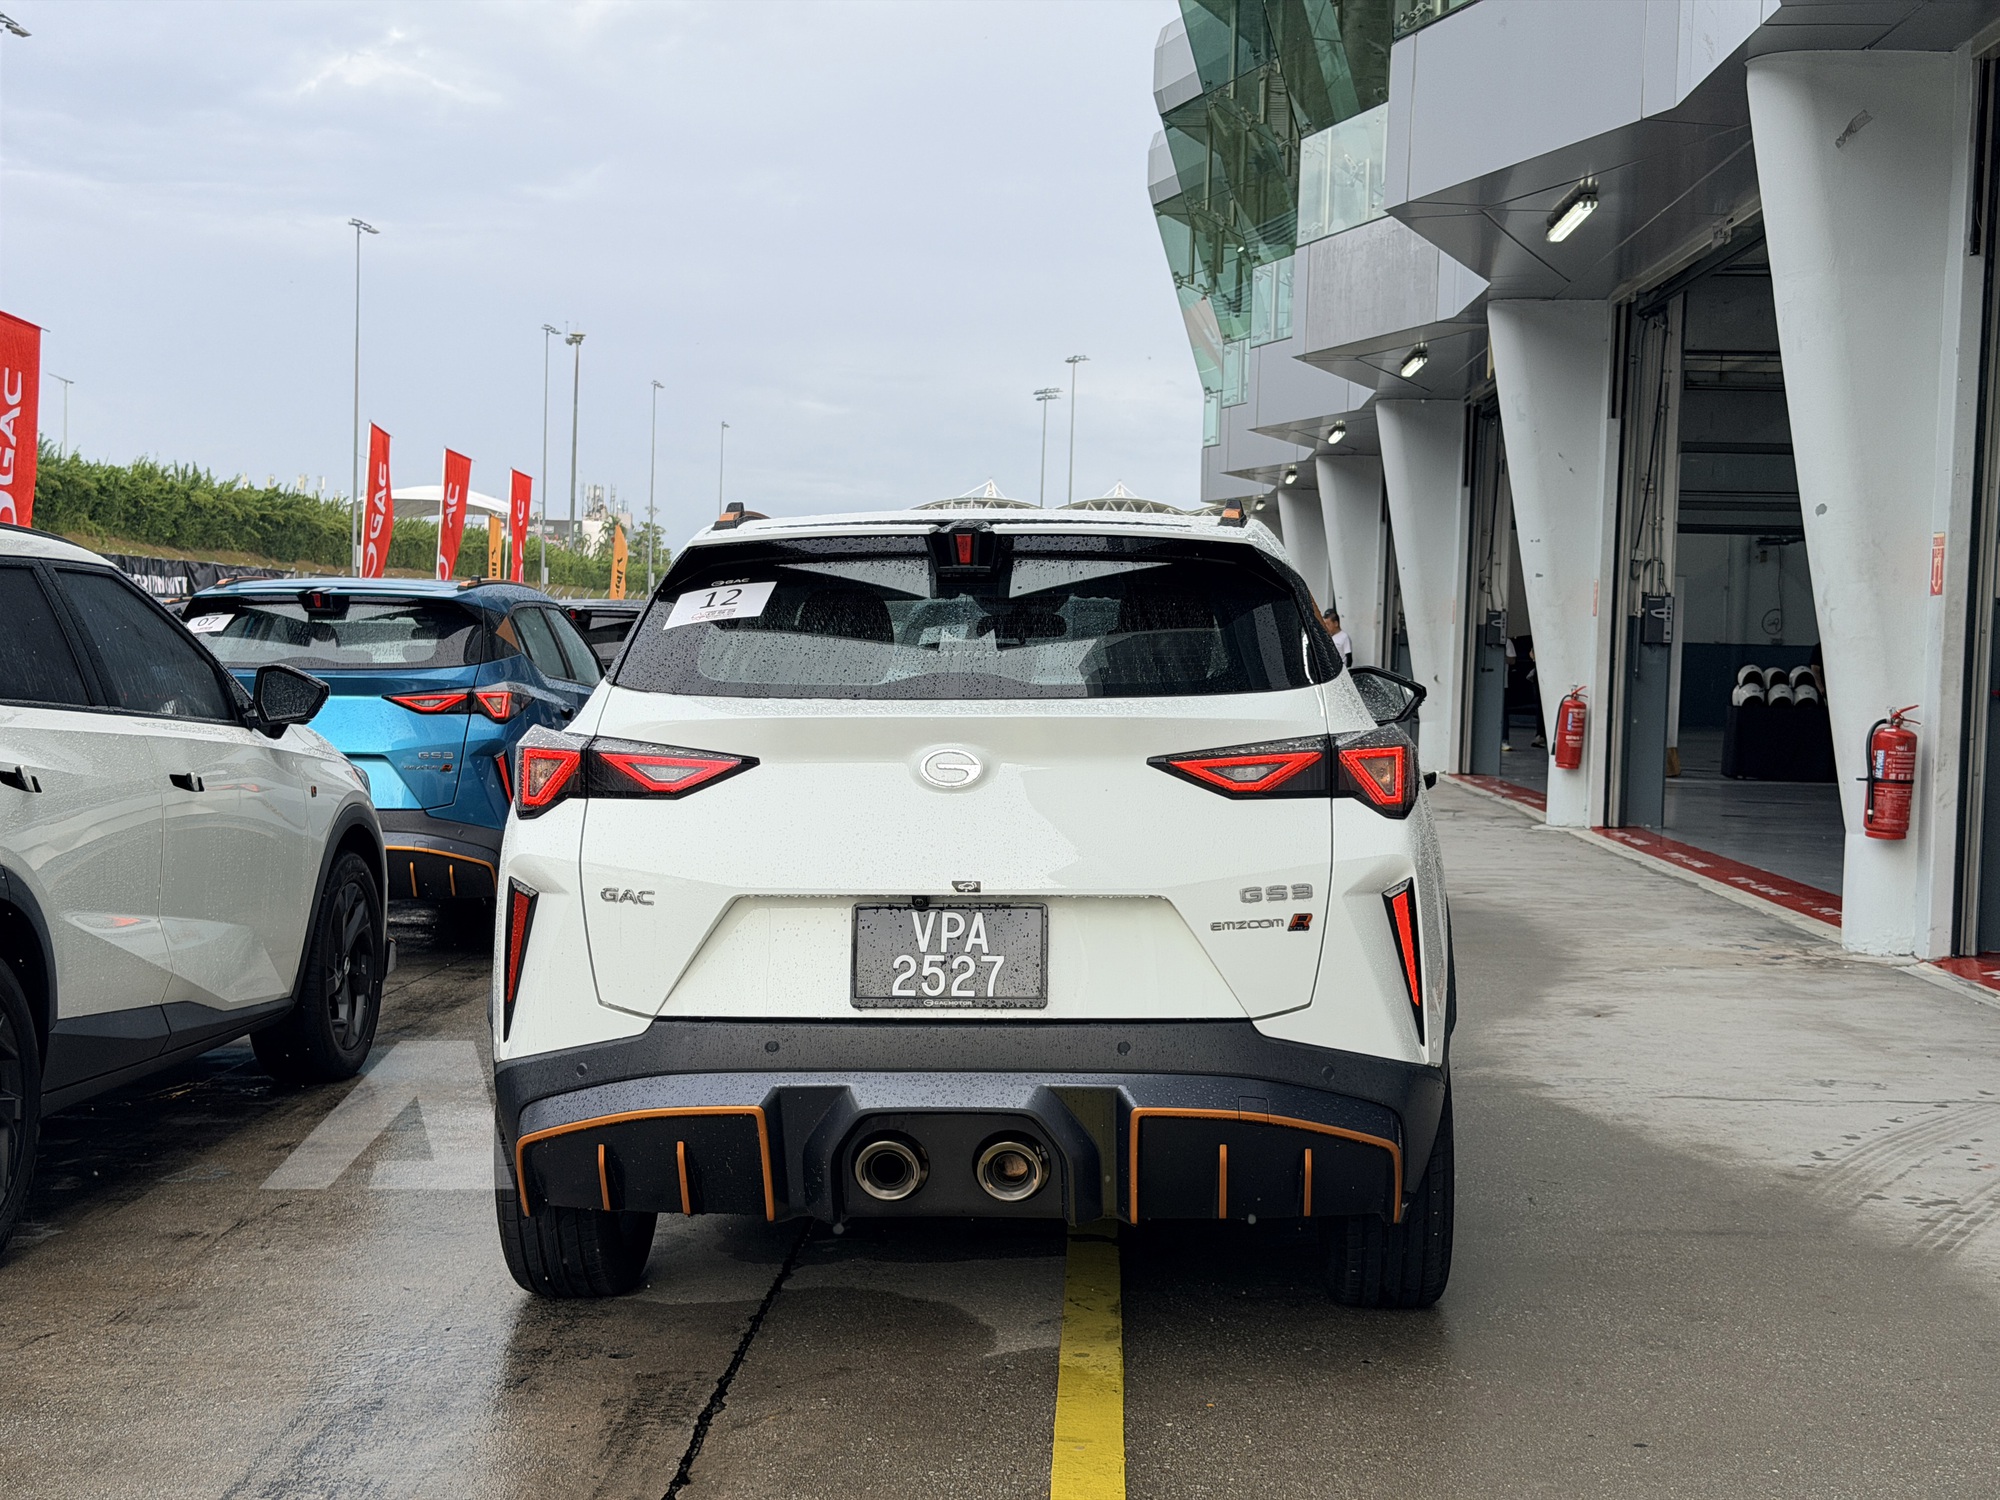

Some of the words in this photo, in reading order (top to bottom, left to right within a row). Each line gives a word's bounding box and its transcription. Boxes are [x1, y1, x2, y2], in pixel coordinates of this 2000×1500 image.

[369, 461, 388, 539] GAC
[699, 588, 743, 609] 12
[197, 616, 220, 627] 07
[418, 751, 454, 760] GS3
[600, 887, 656, 906] GAC
[1239, 883, 1313, 904] GS3
[911, 911, 990, 954] VPA
[891, 954, 1006, 998] 2527
